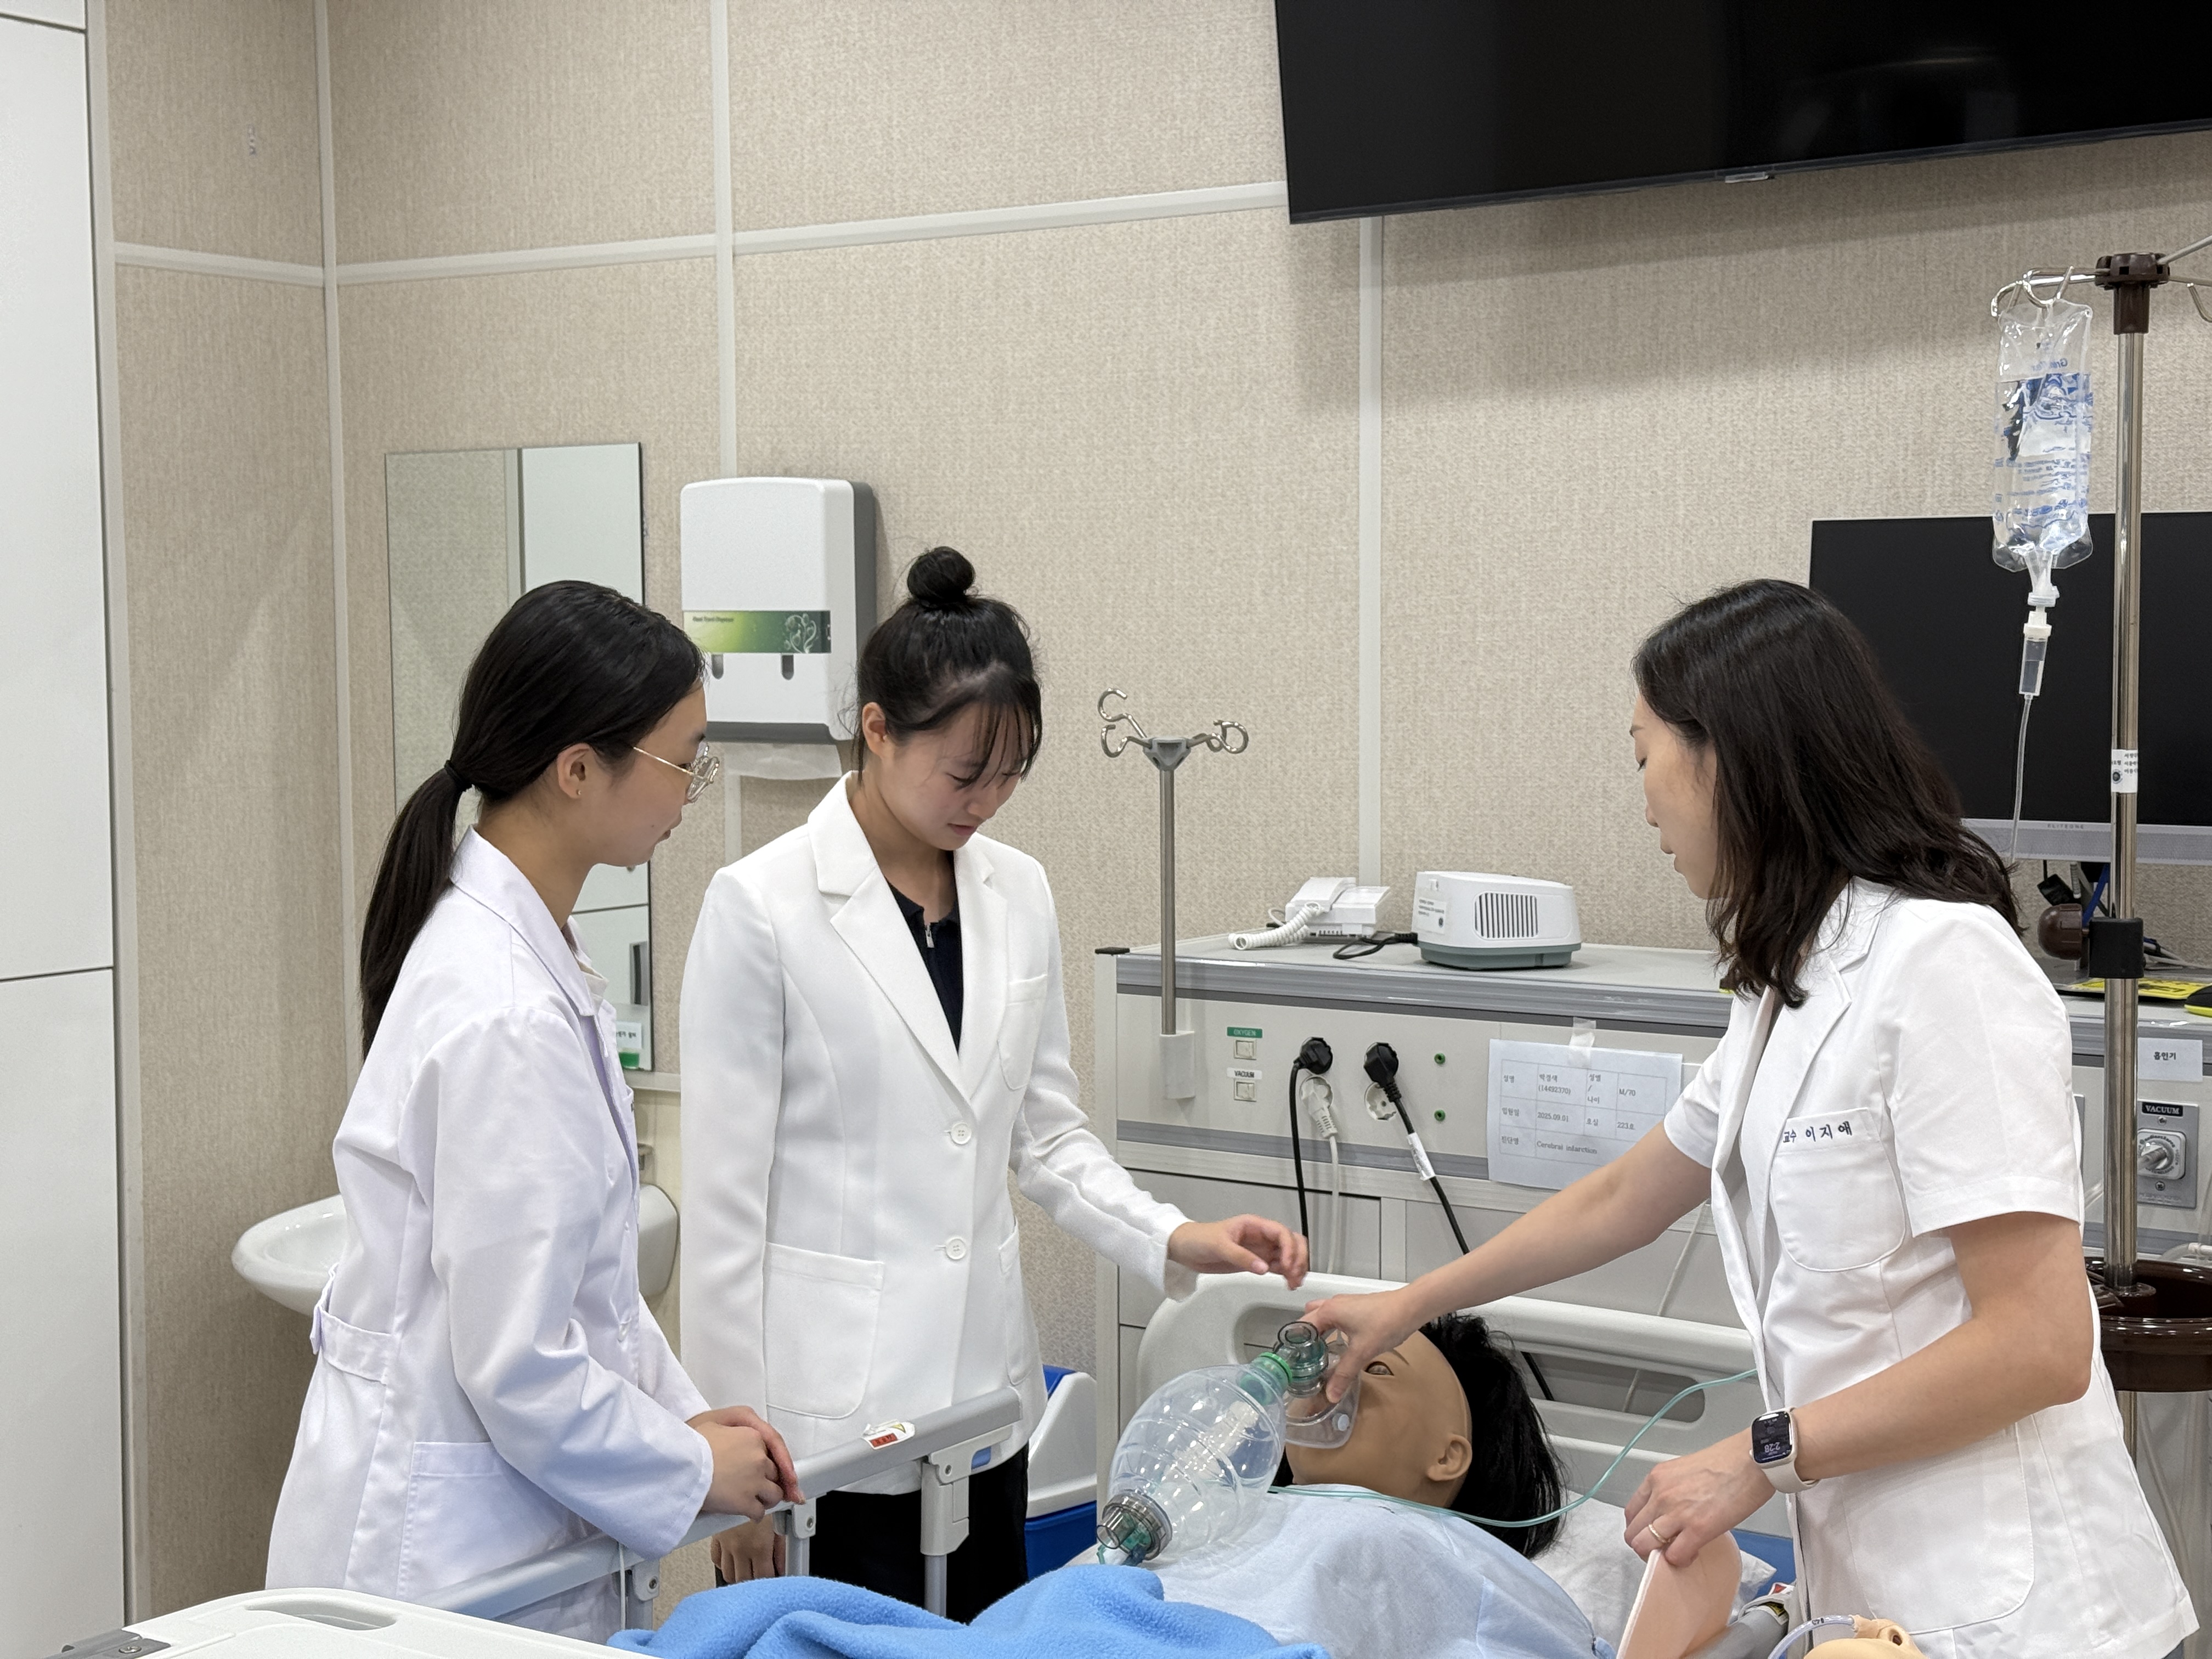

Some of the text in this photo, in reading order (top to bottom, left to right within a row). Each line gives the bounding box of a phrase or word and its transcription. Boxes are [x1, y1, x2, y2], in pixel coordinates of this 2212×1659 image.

[2145, 1105, 2180, 1115] VACUUM
[1536, 1141, 1598, 1154] Cerebral infarction
